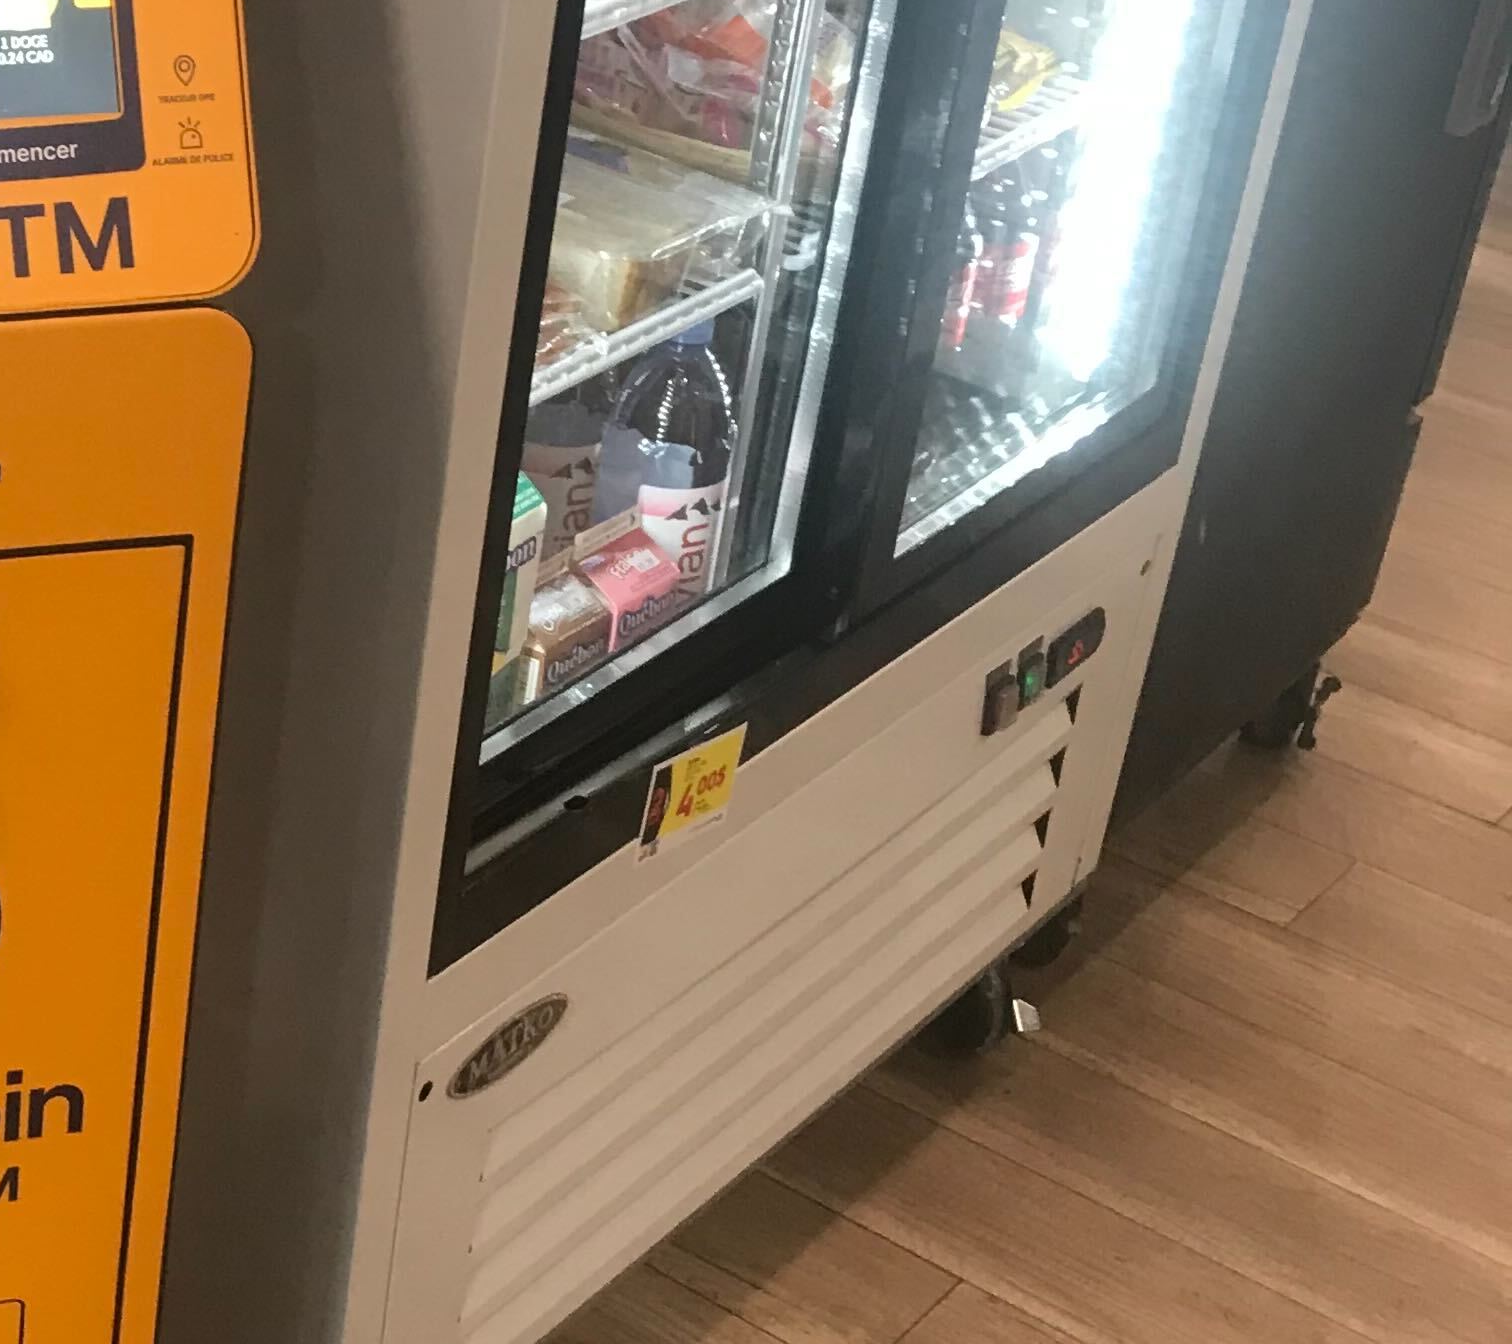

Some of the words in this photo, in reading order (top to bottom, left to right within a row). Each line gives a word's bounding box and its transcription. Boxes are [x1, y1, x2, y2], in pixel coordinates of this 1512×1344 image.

[0, 36, 8, 50] 1
[10, 34, 49, 49] DOGE
[25, 48, 55, 64] CAD
